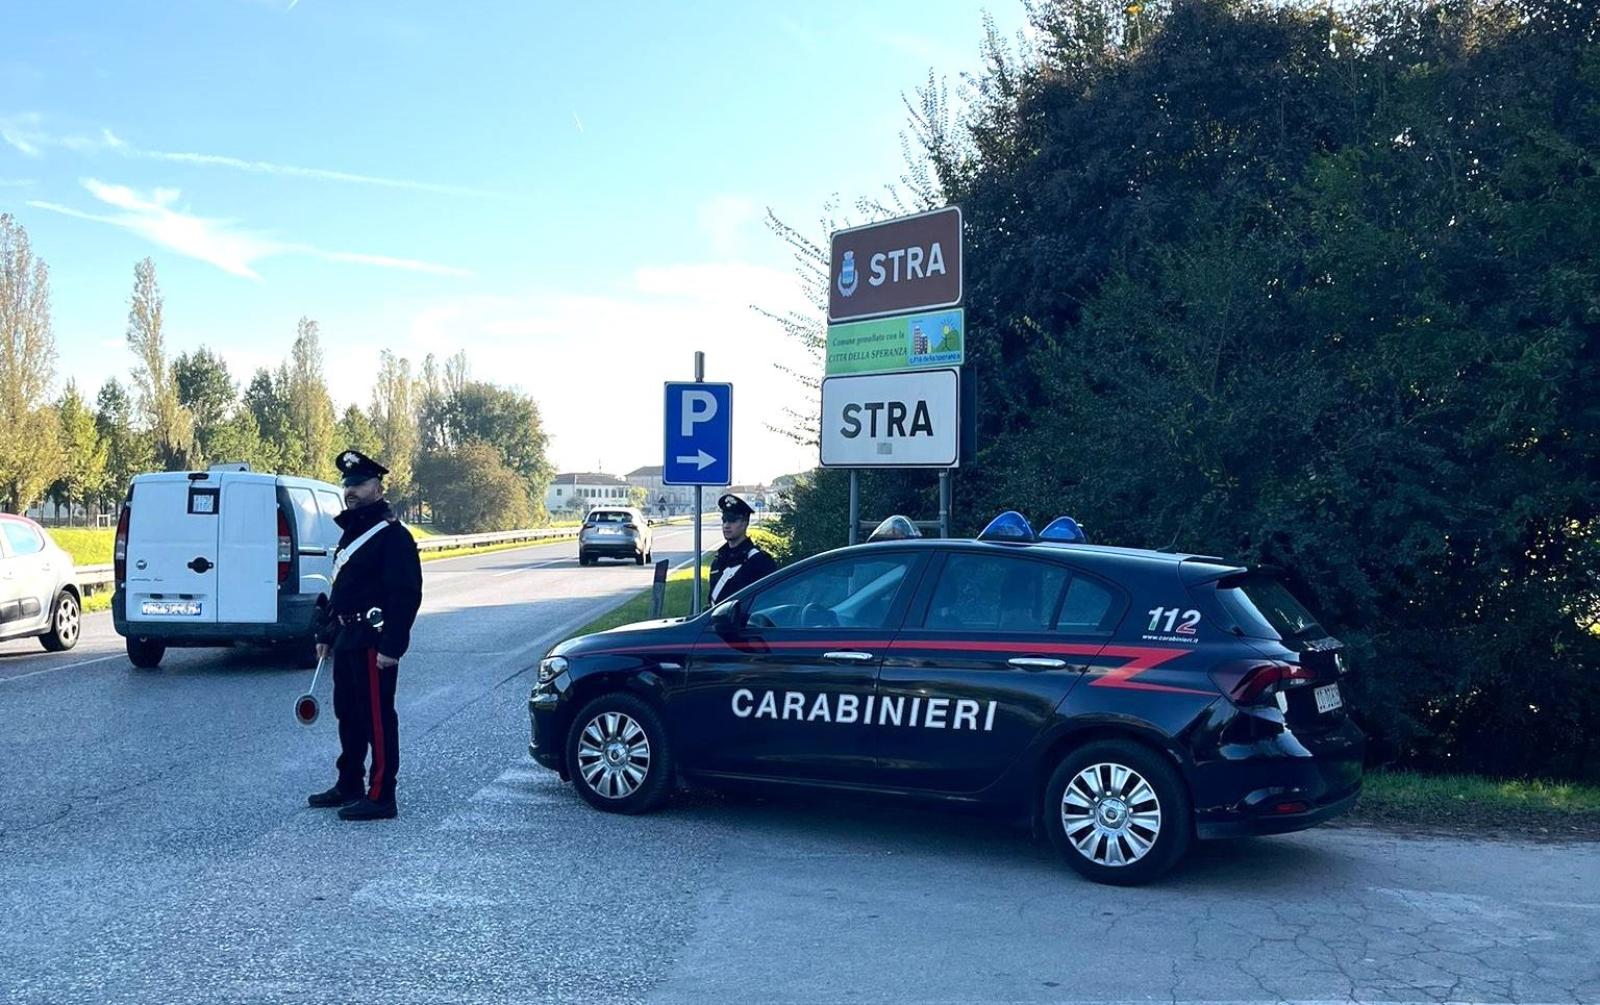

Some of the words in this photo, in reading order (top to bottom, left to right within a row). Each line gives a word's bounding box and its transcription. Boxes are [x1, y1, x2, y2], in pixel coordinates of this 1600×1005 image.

[868, 242, 946, 286] STRA
[848, 351, 870, 361] DELLA
[871, 346, 907, 359] SPERANZA
[681, 389, 718, 437] P
[840, 400, 934, 439] STRA
[1148, 606, 1202, 635] 112
[731, 688, 998, 731] CARABINIERI
